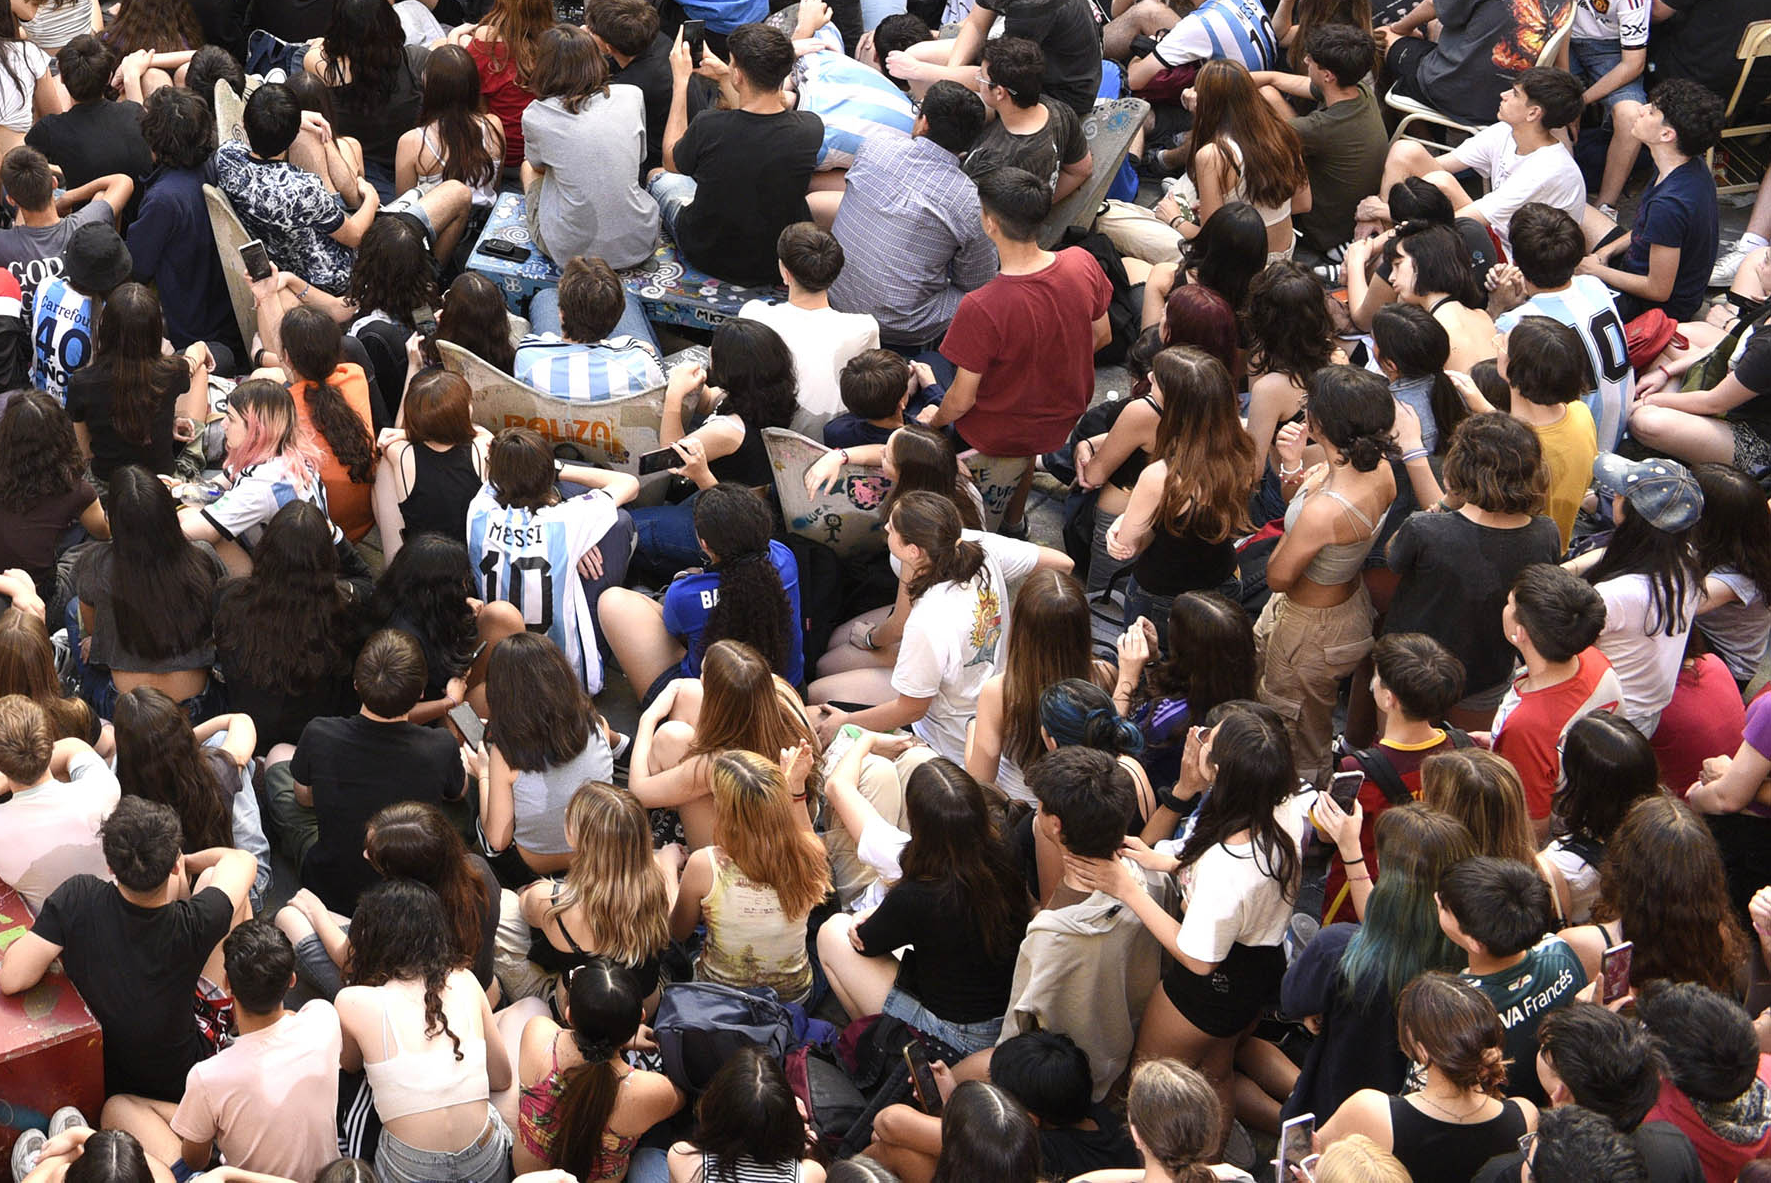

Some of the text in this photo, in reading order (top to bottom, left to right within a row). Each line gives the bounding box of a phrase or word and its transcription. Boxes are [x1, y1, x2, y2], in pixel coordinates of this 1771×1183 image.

[41, 293, 92, 326] Carrefou
[35, 316, 94, 375] 40
[488, 521, 542, 549] MESSI
[478, 549, 553, 636] 10
[1498, 968, 1574, 1029] VA Francés
